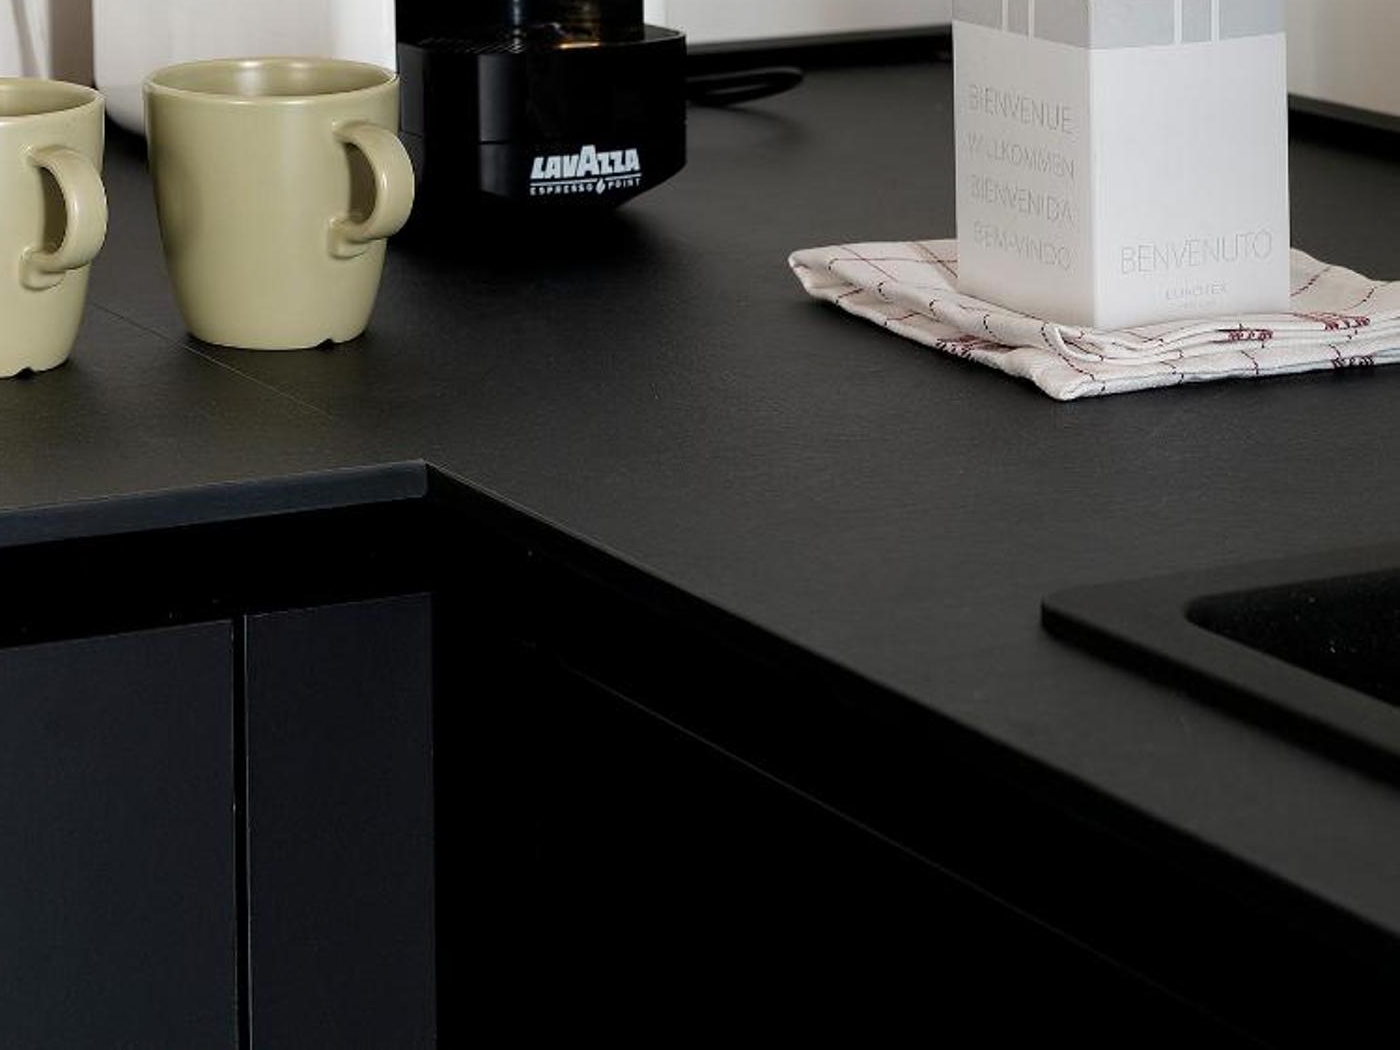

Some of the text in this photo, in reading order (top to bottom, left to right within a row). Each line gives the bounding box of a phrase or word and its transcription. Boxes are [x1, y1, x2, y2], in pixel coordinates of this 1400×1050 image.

[967, 83, 1073, 134] BIENVENUE
[530, 144, 640, 179] LAVAZZA
[968, 132, 1075, 180] WLLKOMMEN
[529, 178, 640, 196] ESPRESSO POINT
[970, 173, 1074, 223] BIENVENIDA
[1120, 230, 1273, 275] BENVENUTO
